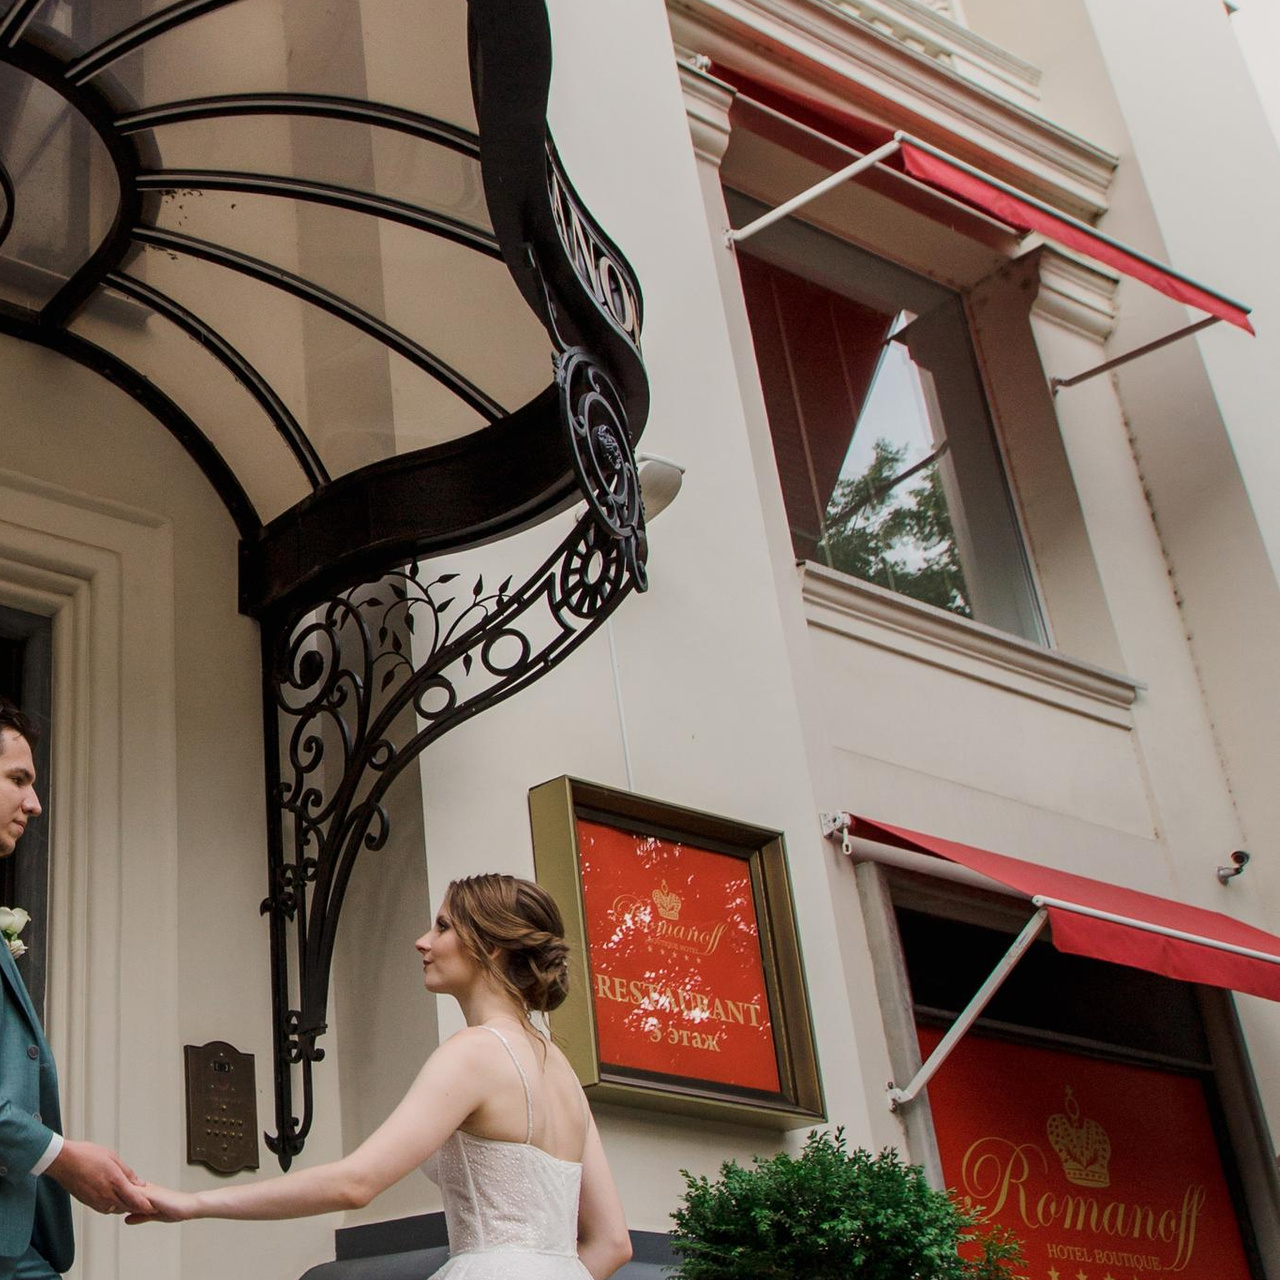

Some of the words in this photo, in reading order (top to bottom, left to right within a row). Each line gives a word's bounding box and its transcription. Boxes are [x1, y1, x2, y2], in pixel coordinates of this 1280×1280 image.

[595, 973, 761, 1027] RESTAURANT
[667, 1027, 721, 1052] этаж
[961, 1136, 1207, 1272] Romanoff
[1046, 1243, 1093, 1263] HOTEL
[1094, 1249, 1161, 1271] BOUTIQUE
